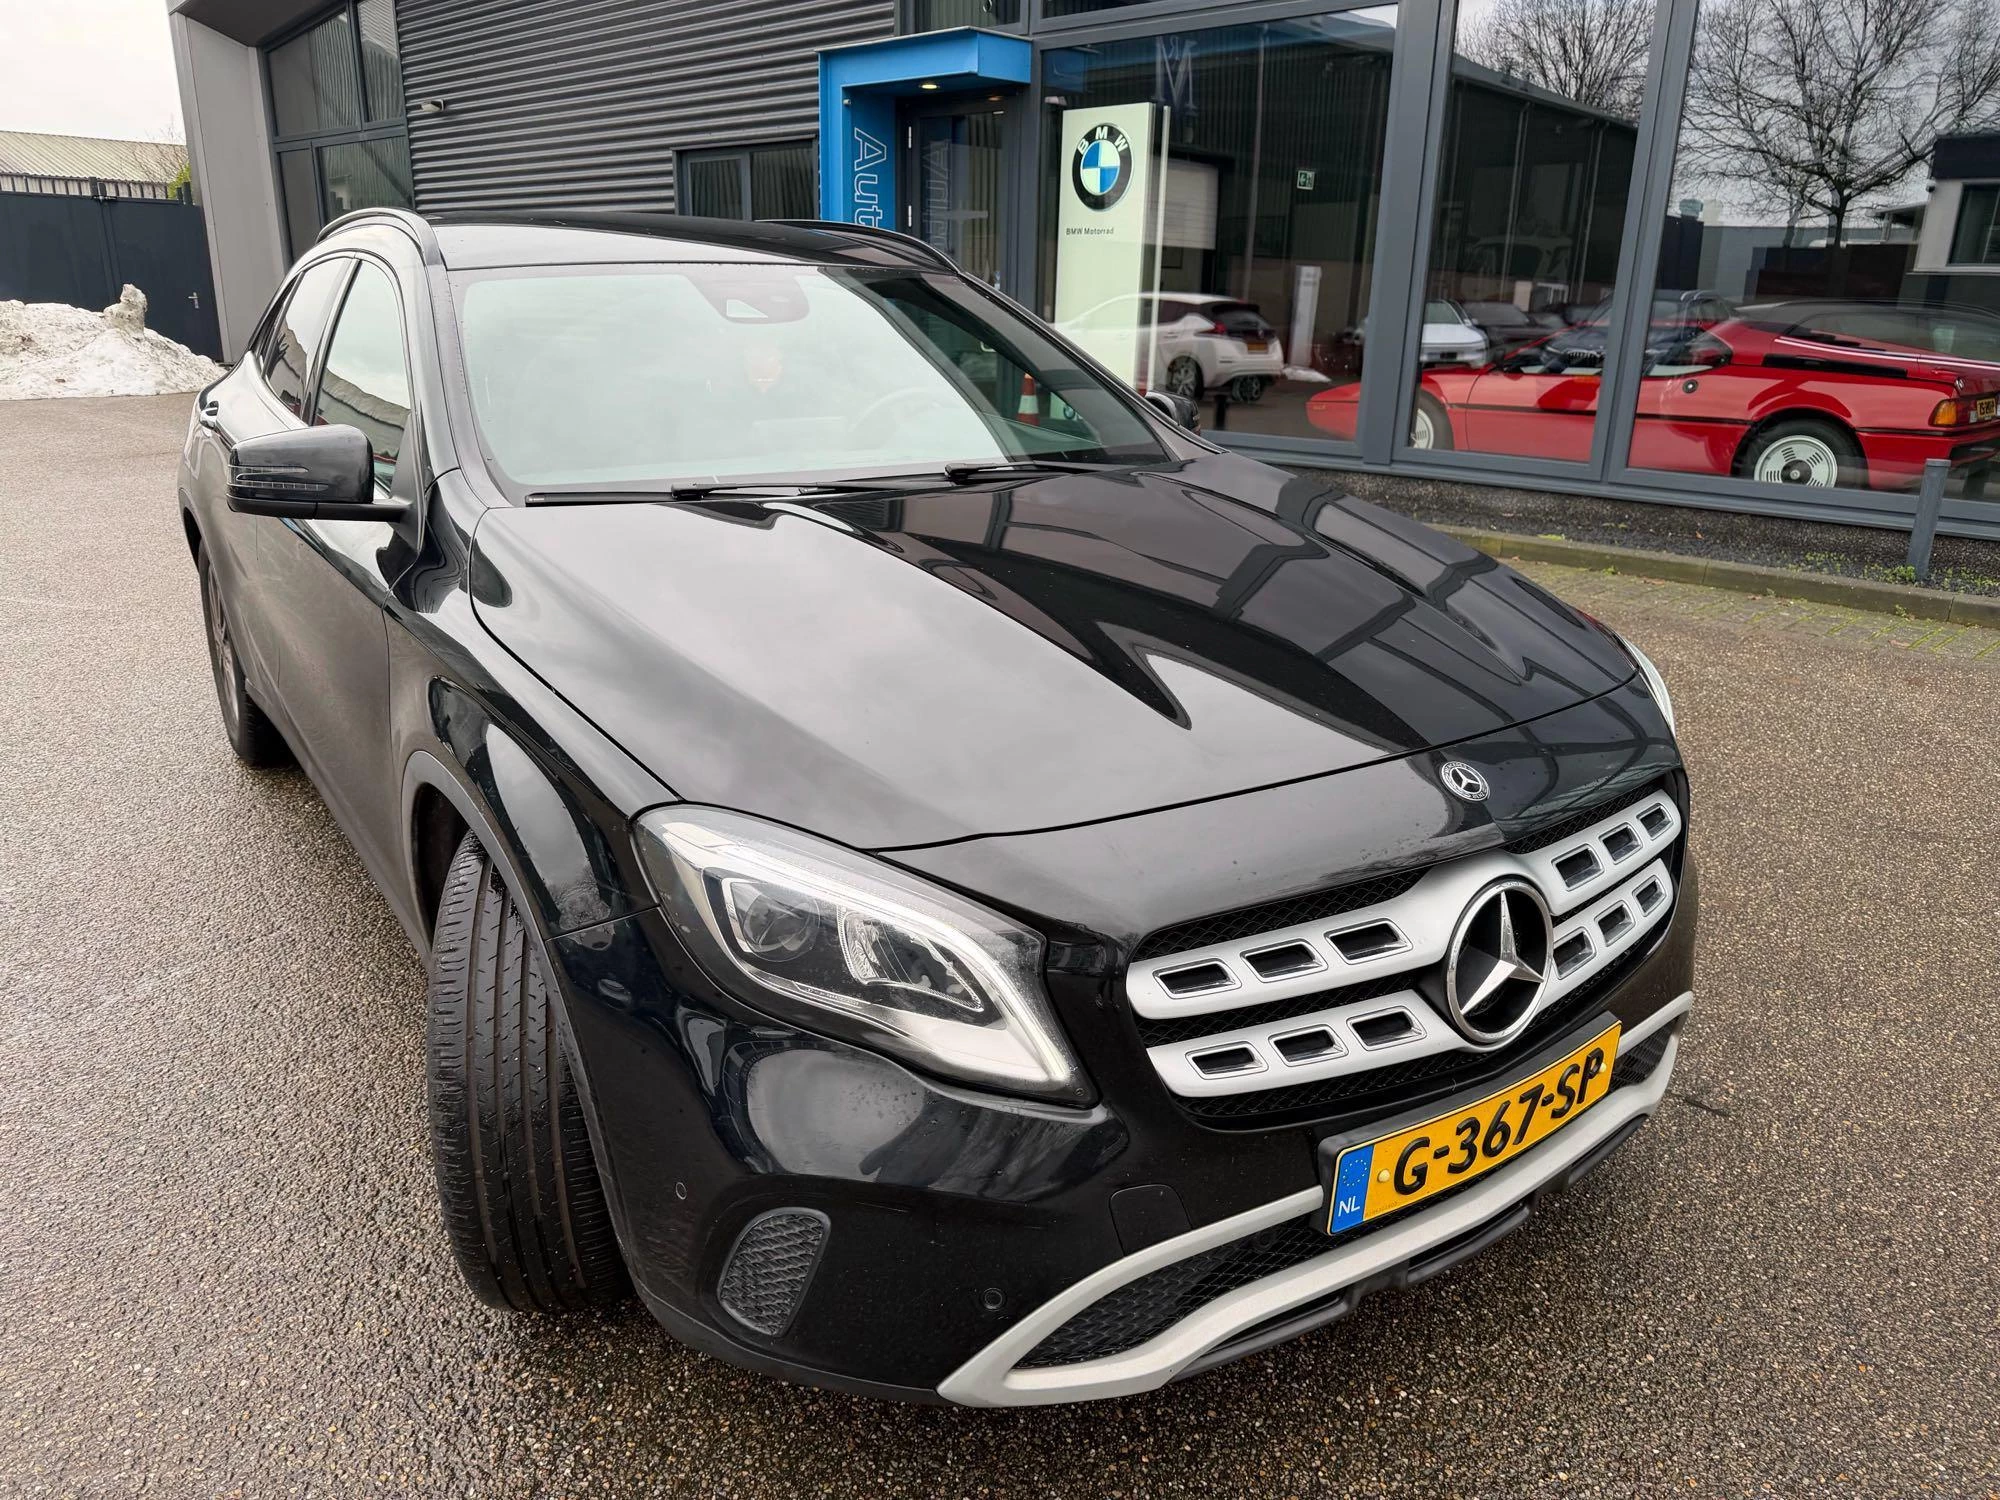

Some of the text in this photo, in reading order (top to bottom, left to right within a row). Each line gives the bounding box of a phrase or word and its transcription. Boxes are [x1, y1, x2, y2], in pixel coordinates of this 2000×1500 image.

[1077, 126, 1129, 155] BMW
[1065, 226, 1114, 236] BMW Motorrad
[1393, 1047, 1605, 1196] G-367-SP
[1338, 1195, 1361, 1217] NL
